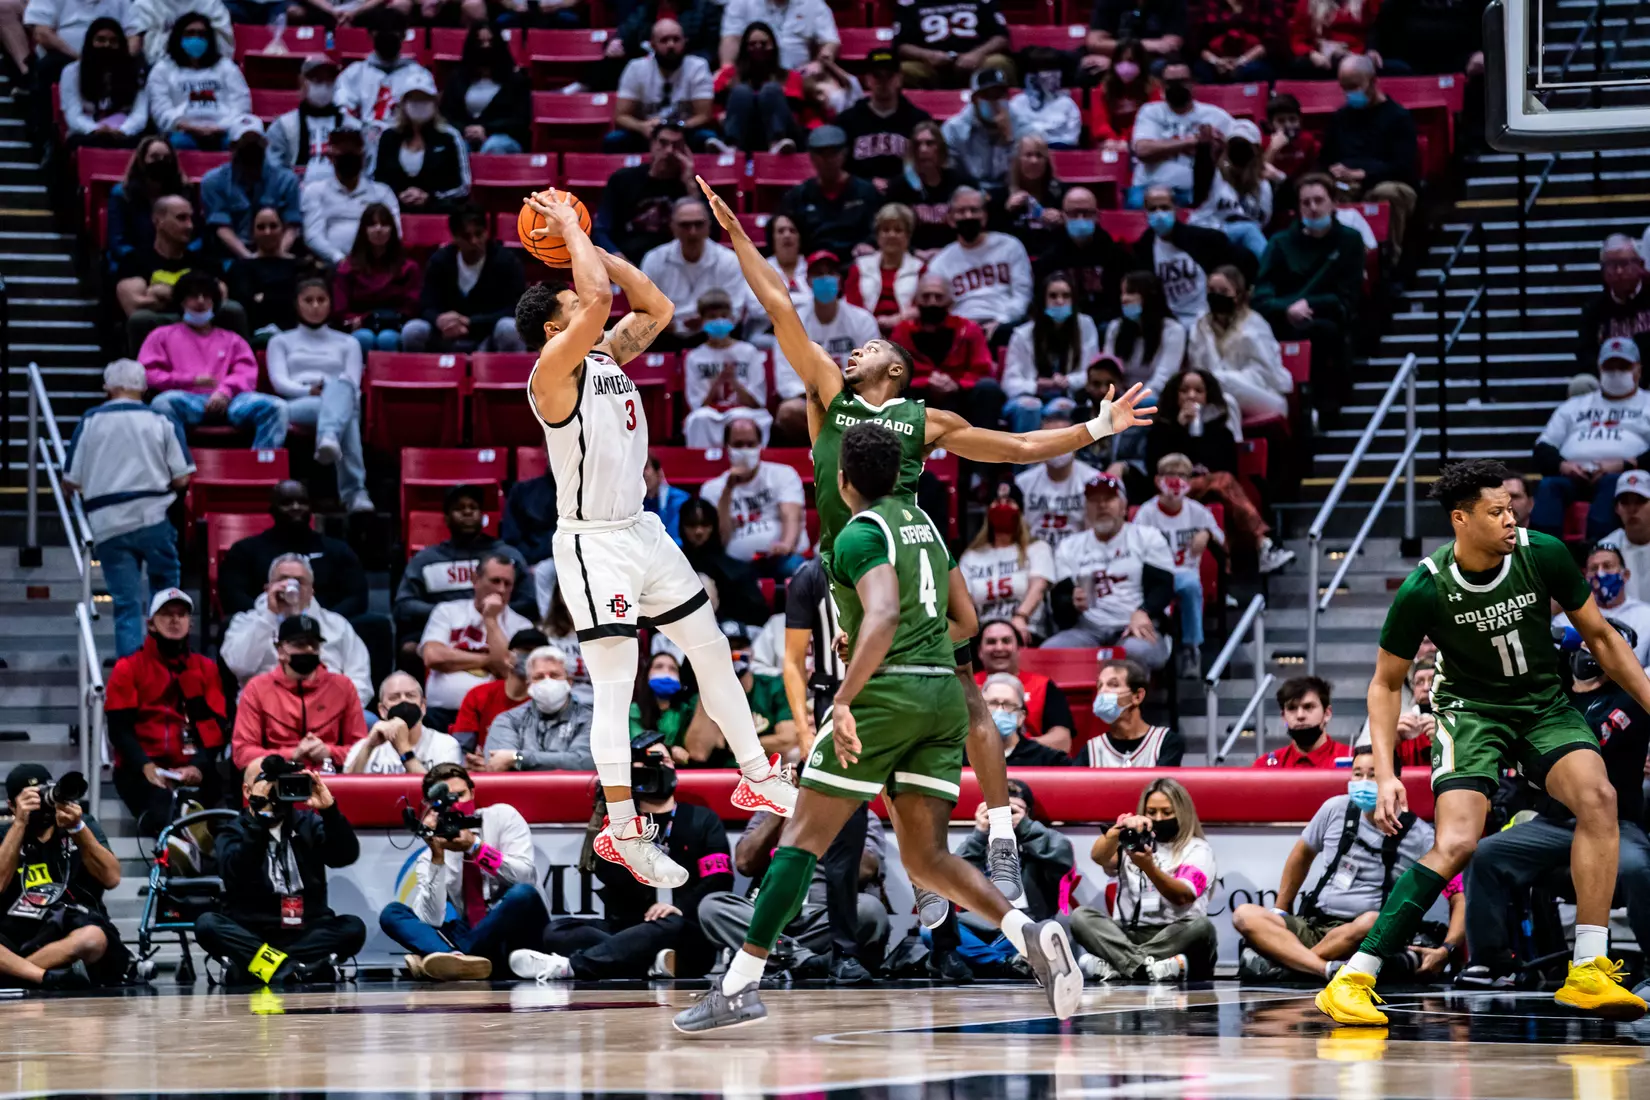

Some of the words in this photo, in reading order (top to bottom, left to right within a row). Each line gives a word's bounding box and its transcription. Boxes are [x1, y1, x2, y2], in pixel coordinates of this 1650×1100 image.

[624, 399, 637, 431] 3
[899, 523, 935, 545] STEVENS
[919, 548, 938, 618] 4
[986, 576, 1013, 601] 15
[1454, 592, 1538, 625] COLORADO
[1476, 609, 1524, 632] STATE
[1490, 629, 1529, 677] 11
